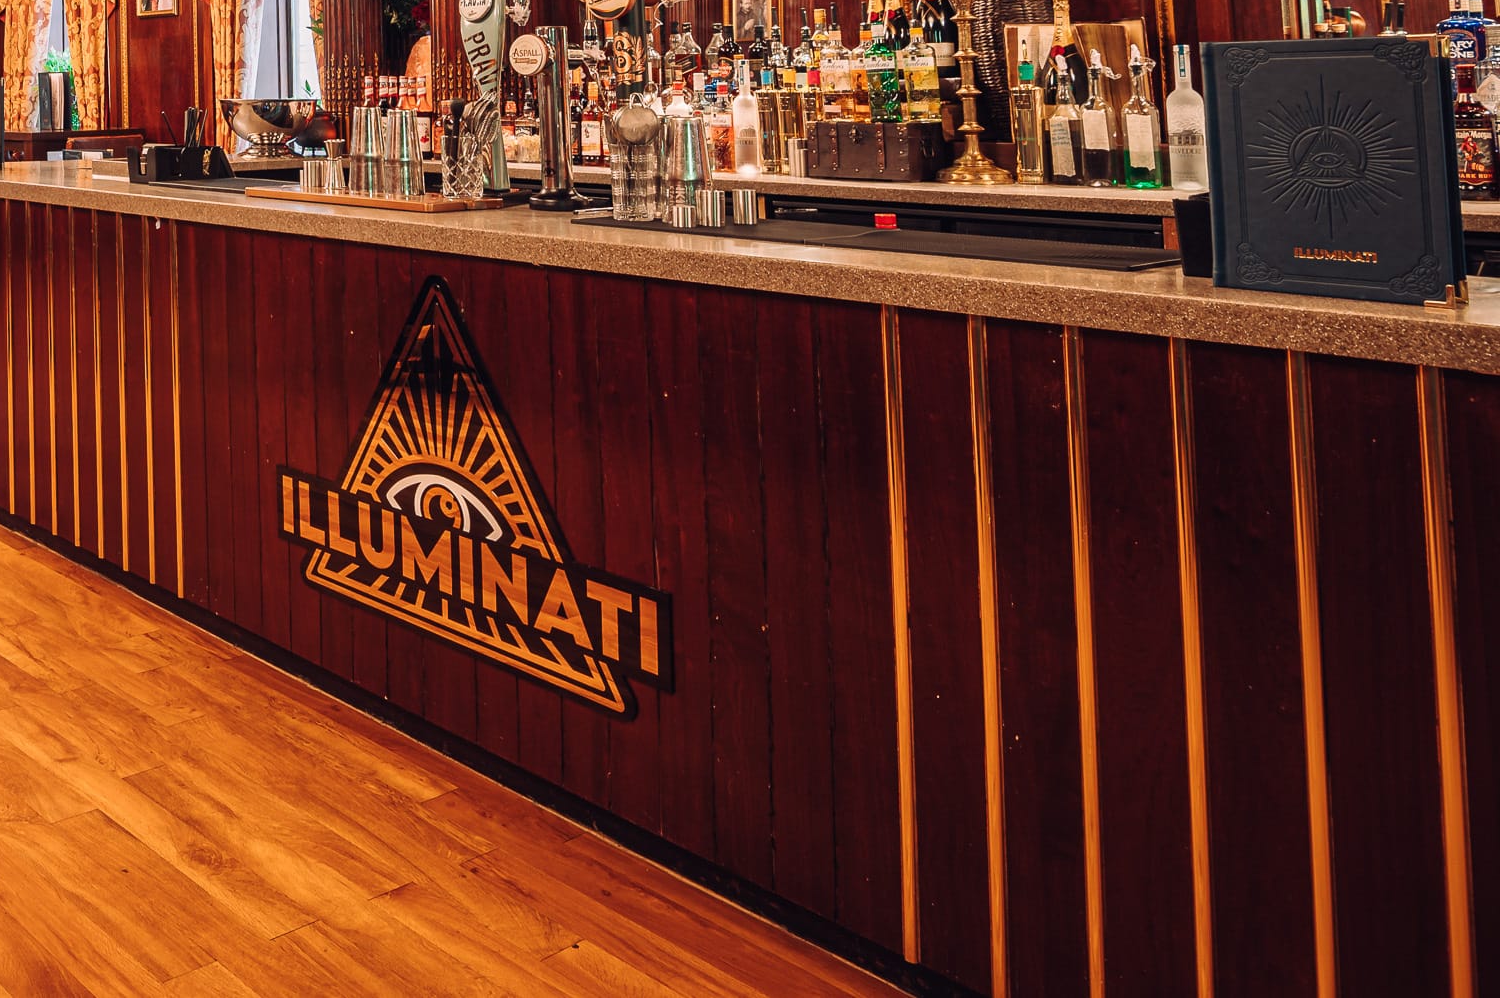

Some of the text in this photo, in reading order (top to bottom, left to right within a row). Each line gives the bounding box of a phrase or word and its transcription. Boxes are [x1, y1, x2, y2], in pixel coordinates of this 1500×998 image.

[513, 48, 540, 57] ASPALL
[1450, 40, 1474, 49] ARY
[464, 31, 498, 92] PRAV
[1294, 247, 1378, 263] ILLUMINATI
[282, 475, 659, 676] ILLUMINATI
